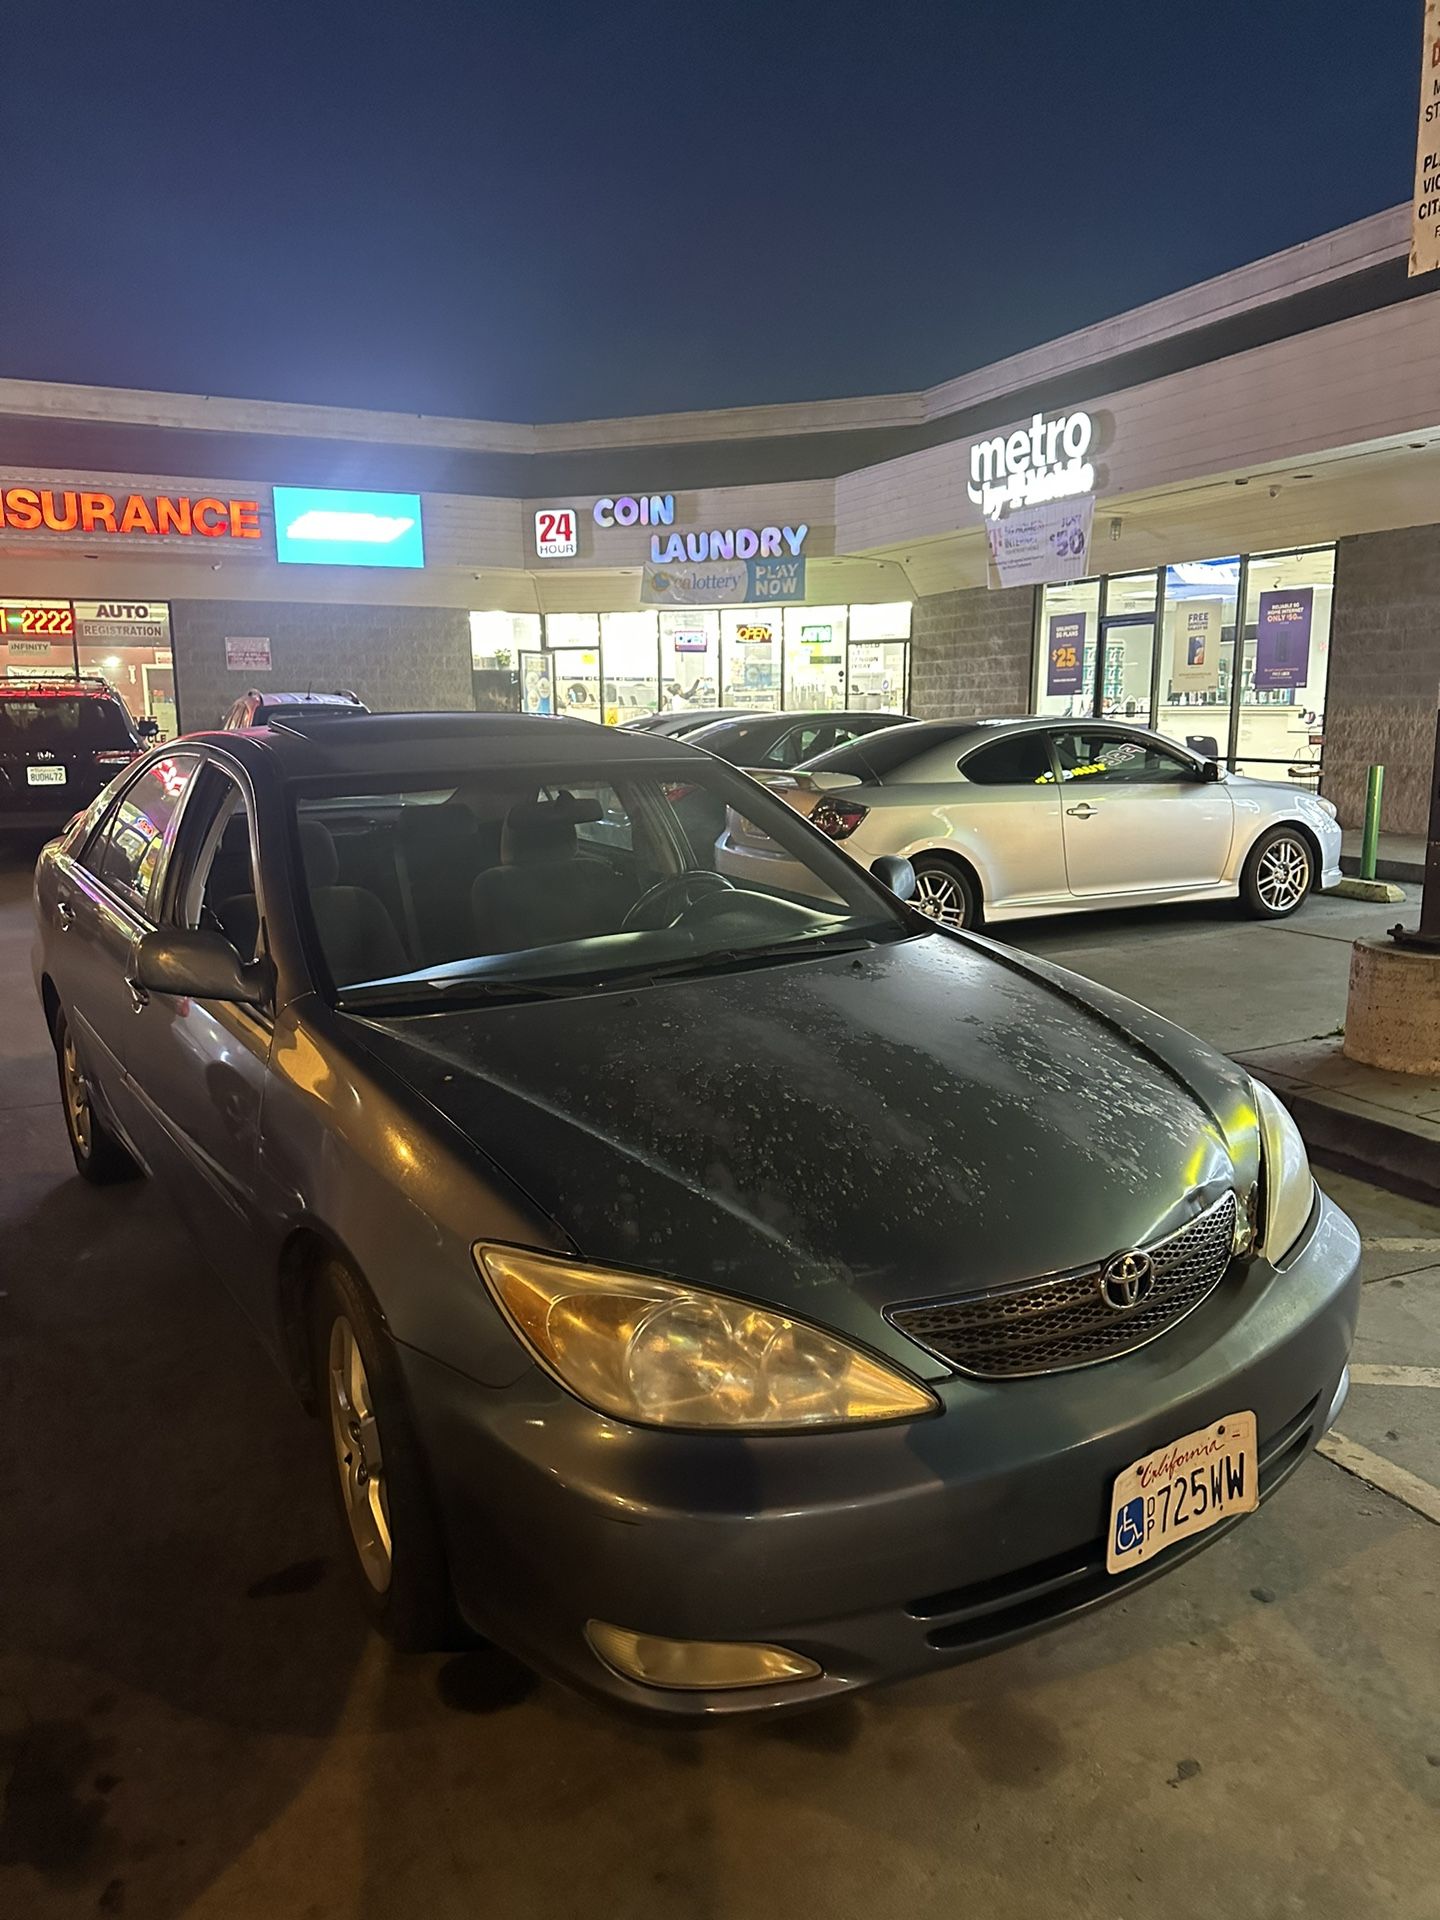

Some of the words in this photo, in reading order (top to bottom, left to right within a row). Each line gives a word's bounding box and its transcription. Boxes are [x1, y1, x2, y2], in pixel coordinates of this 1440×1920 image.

[1419, 198, 1440, 220] CIT
[971, 411, 1092, 482] metro
[0, 488, 262, 539] SURANCE
[593, 494, 675, 528] COIN
[539, 513, 573, 543] 24
[539, 543, 574, 555] HOUR
[651, 524, 809, 564] LAUNDRY
[755, 563, 799, 579] PLAY
[755, 579, 797, 596] NOW
[97, 604, 148, 618] AUTO
[1188, 612, 1209, 622] FREE
[84, 624, 162, 636] REGISTRATION
[737, 626, 771, 641] OPEN
[1052, 647, 1076, 668] $25
[1141, 1437, 1226, 1488] California
